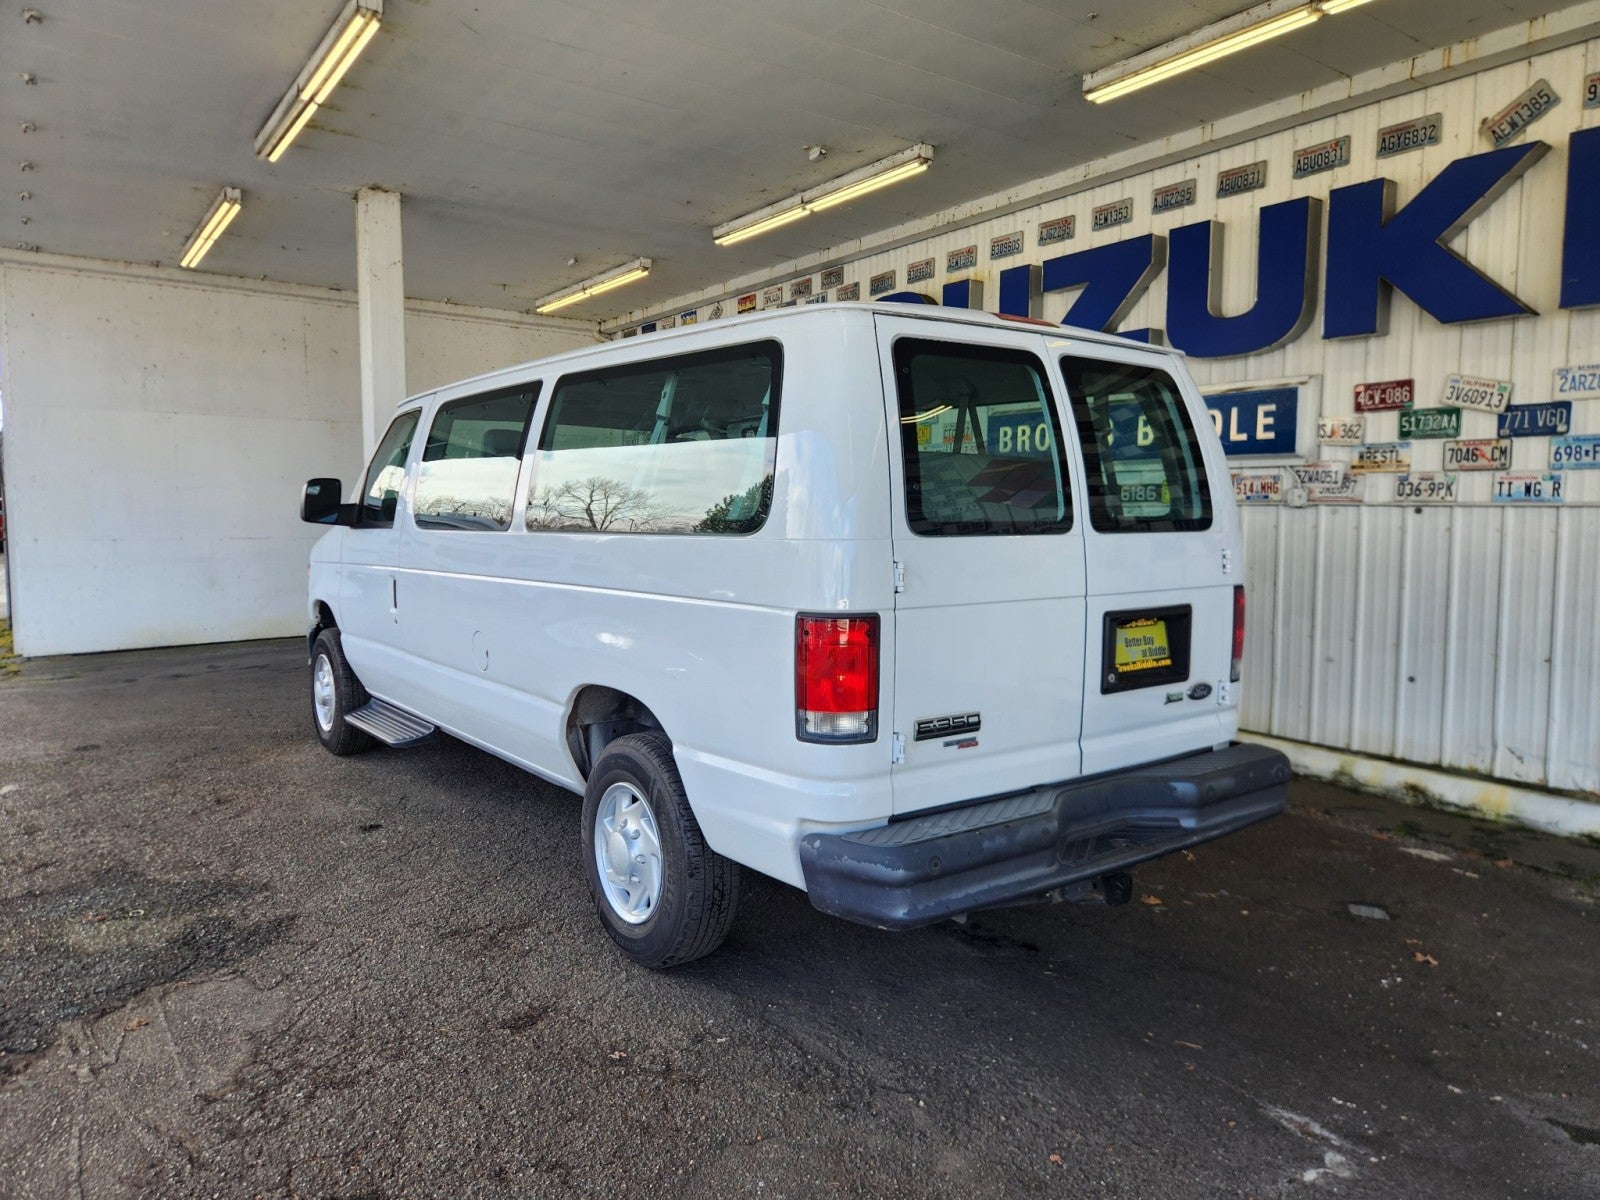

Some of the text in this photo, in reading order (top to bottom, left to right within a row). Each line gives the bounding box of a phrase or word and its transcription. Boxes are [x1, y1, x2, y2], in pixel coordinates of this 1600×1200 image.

[1491, 88, 1551, 144] AEW1385
[1380, 124, 1436, 154] AGY6832
[1295, 147, 1344, 174] ABU0831
[1218, 170, 1261, 193] ABU0831
[876, 126, 1600, 360] ZUKI
[1357, 386, 1411, 406] 4CV-086
[1446, 385, 1504, 409] 3V60913
[1503, 411, 1529, 429] 771
[1358, 449, 1402, 465] WRESTL
[1448, 444, 1508, 464] 7046 CM
[1553, 445, 1582, 462] 698
[1120, 486, 1156, 501] 6186
[1236, 482, 1254, 496] 514
[1552, 481, 1561, 498] R
